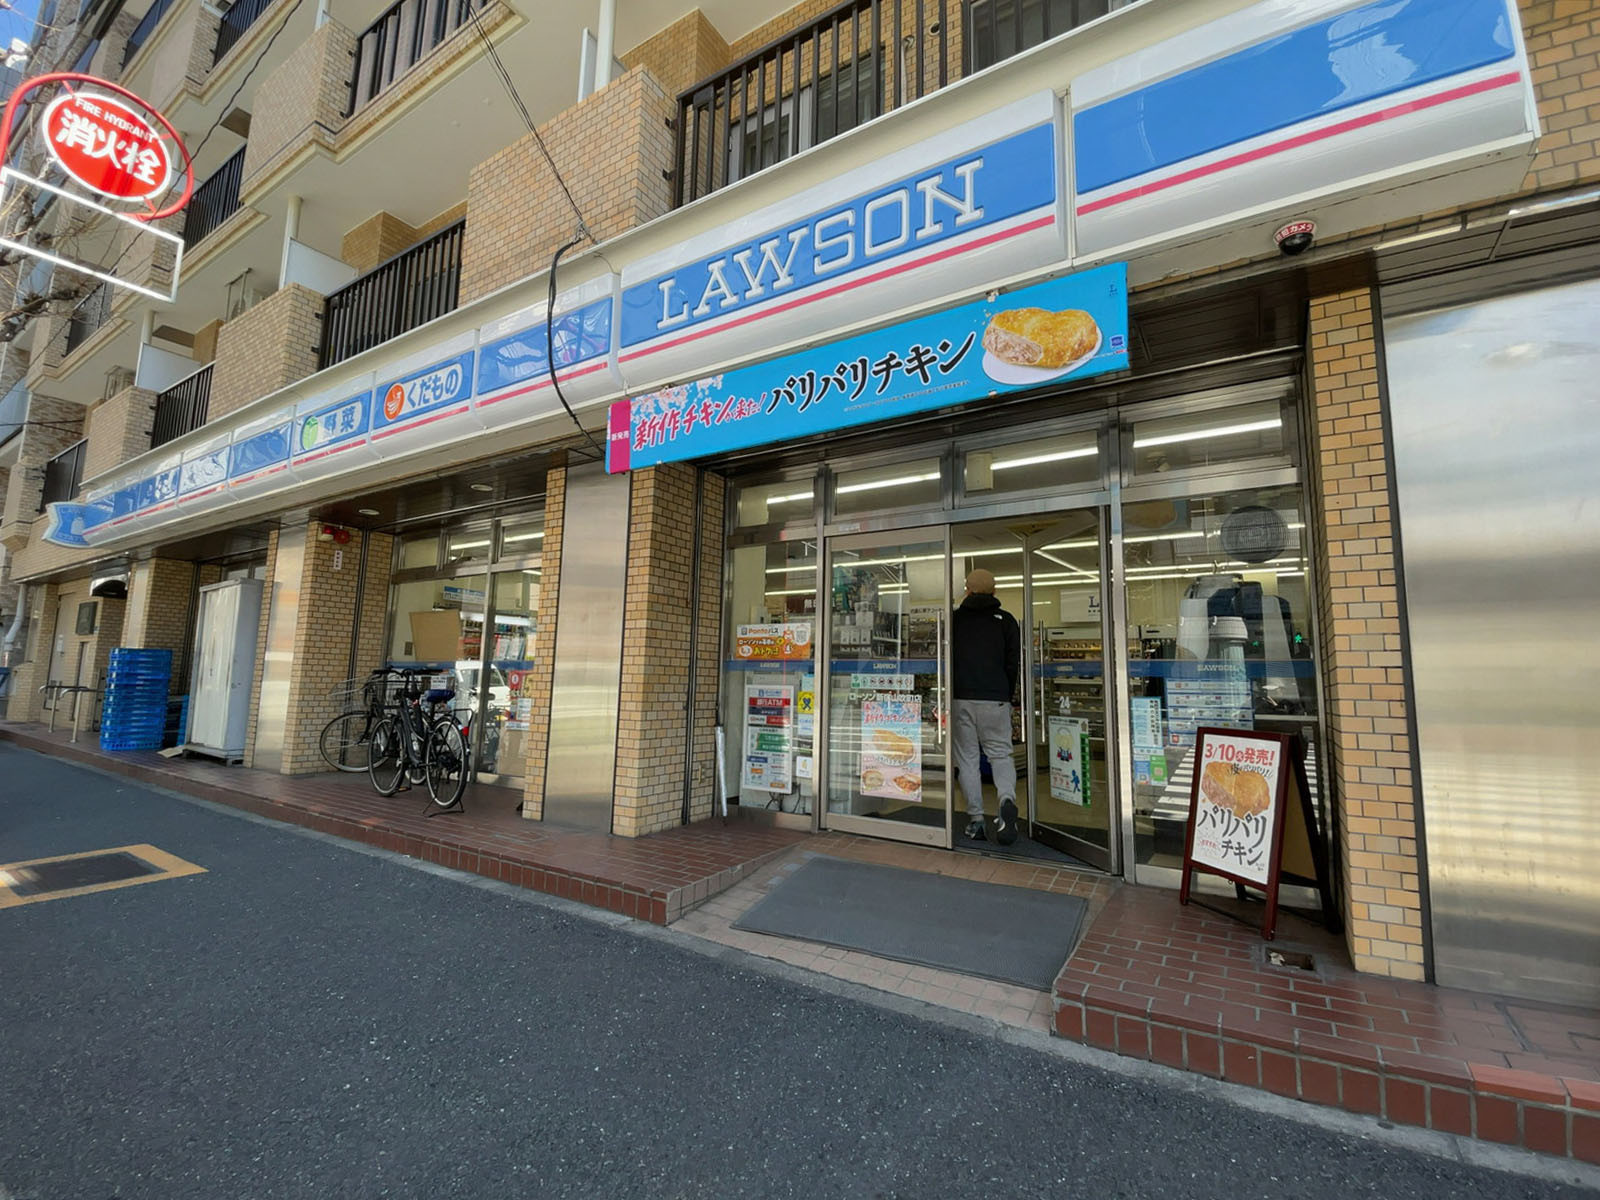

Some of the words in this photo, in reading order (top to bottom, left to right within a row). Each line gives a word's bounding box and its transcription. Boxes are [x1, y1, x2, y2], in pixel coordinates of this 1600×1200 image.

[75, 97, 104, 118] FIRE
[103, 111, 156, 143] HYDRANT
[56, 107, 161, 186] 消火栓
[656, 157, 985, 331] LAWSON
[406, 369, 459, 408] くだもの
[766, 332, 976, 414] パリパリチキン
[324, 405, 355, 435] 野菜
[1197, 805, 1267, 849] パリパリ
[1221, 839, 1263, 866] チキン
